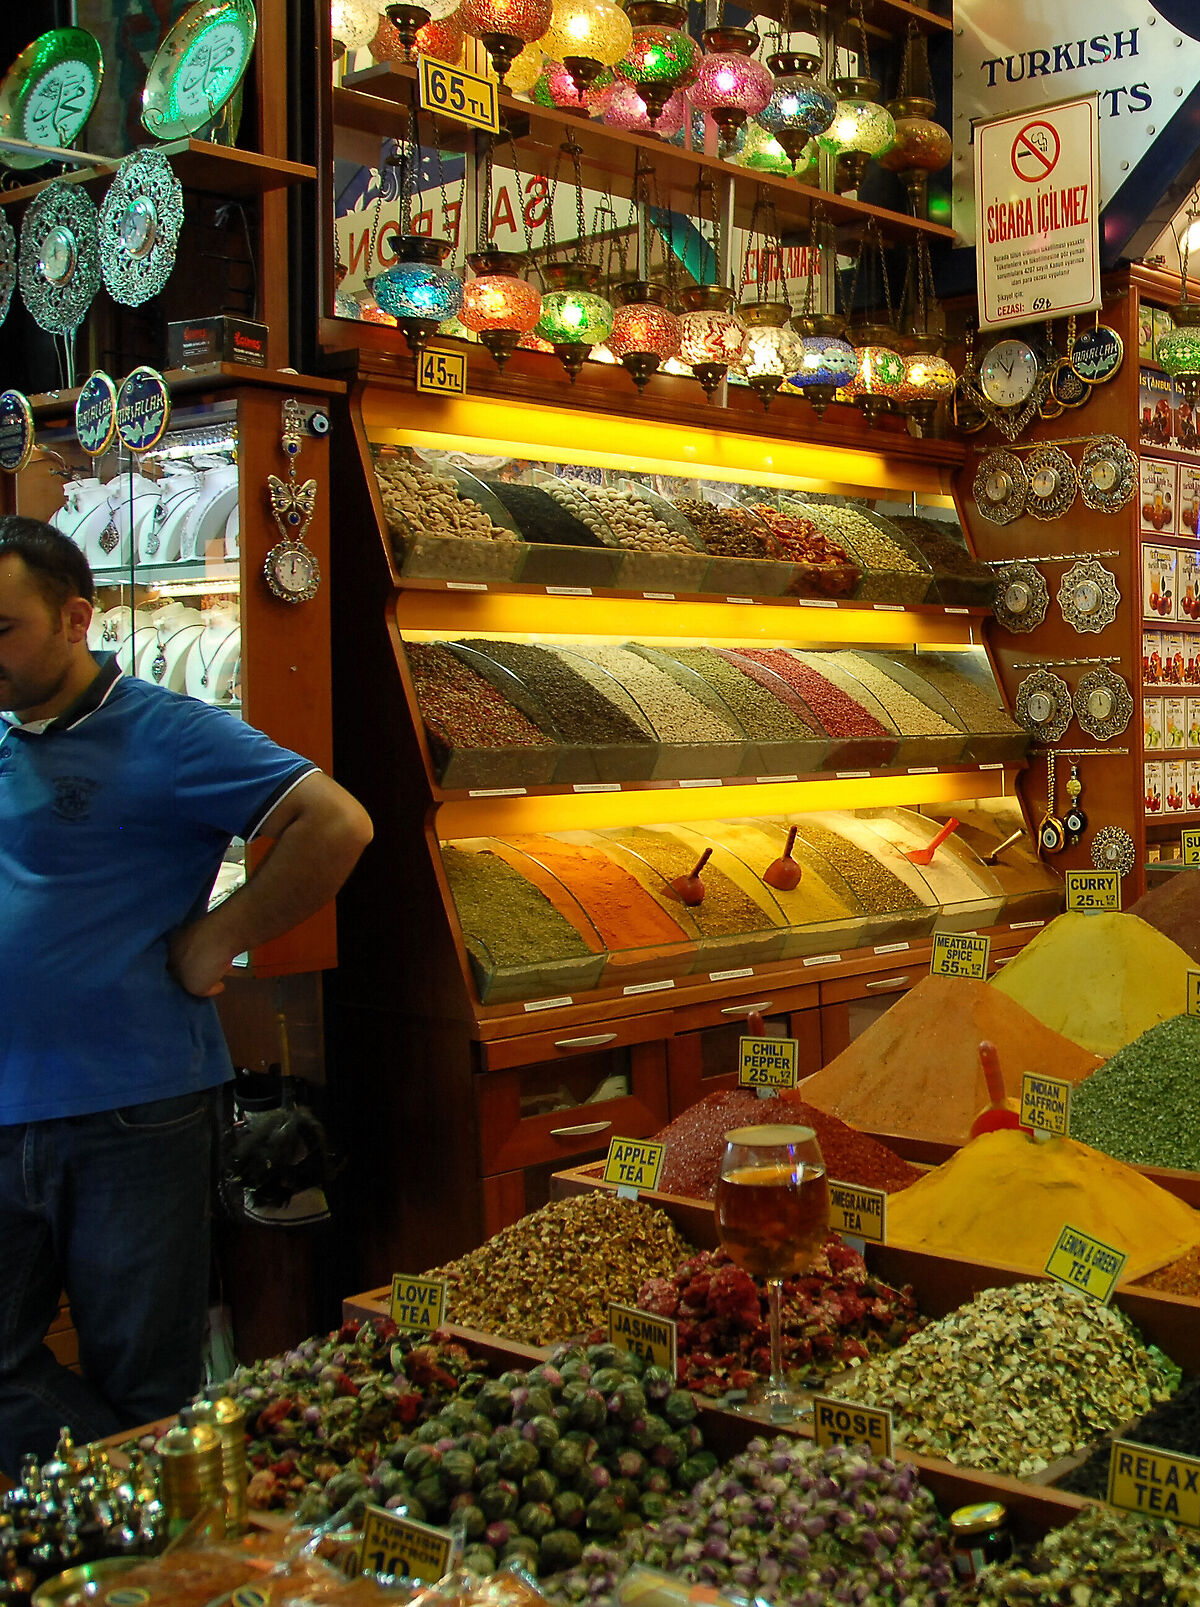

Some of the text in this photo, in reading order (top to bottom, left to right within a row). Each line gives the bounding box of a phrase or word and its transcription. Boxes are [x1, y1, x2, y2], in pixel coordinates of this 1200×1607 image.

[981, 27, 1140, 88] TURKISH
[987, 184, 1089, 244] SİGARA İÇİLMEZ
[1070, 878, 1115, 892] CURRY
[937, 936, 985, 952] MEATBALL
[946, 949, 972, 962] SPICE
[752, 1043, 785, 1056] CHILI
[743, 1055, 790, 1069] PEPPER
[1030, 1081, 1060, 1098] INDIAN
[1024, 1093, 1064, 1114] SAFFRON
[614, 1145, 657, 1167] APPLE
[619, 1164, 644, 1183] TEA
[842, 1213, 862, 1231] TEA
[1068, 1260, 1093, 1286] TEA
[396, 1285, 438, 1306] LOVE
[400, 1305, 430, 1326] TEA
[613, 1315, 668, 1345] JASMIN
[820, 1408, 882, 1438] ROSE
[1119, 1453, 1200, 1495] RELAX
[1134, 1484, 1179, 1517] TEA
